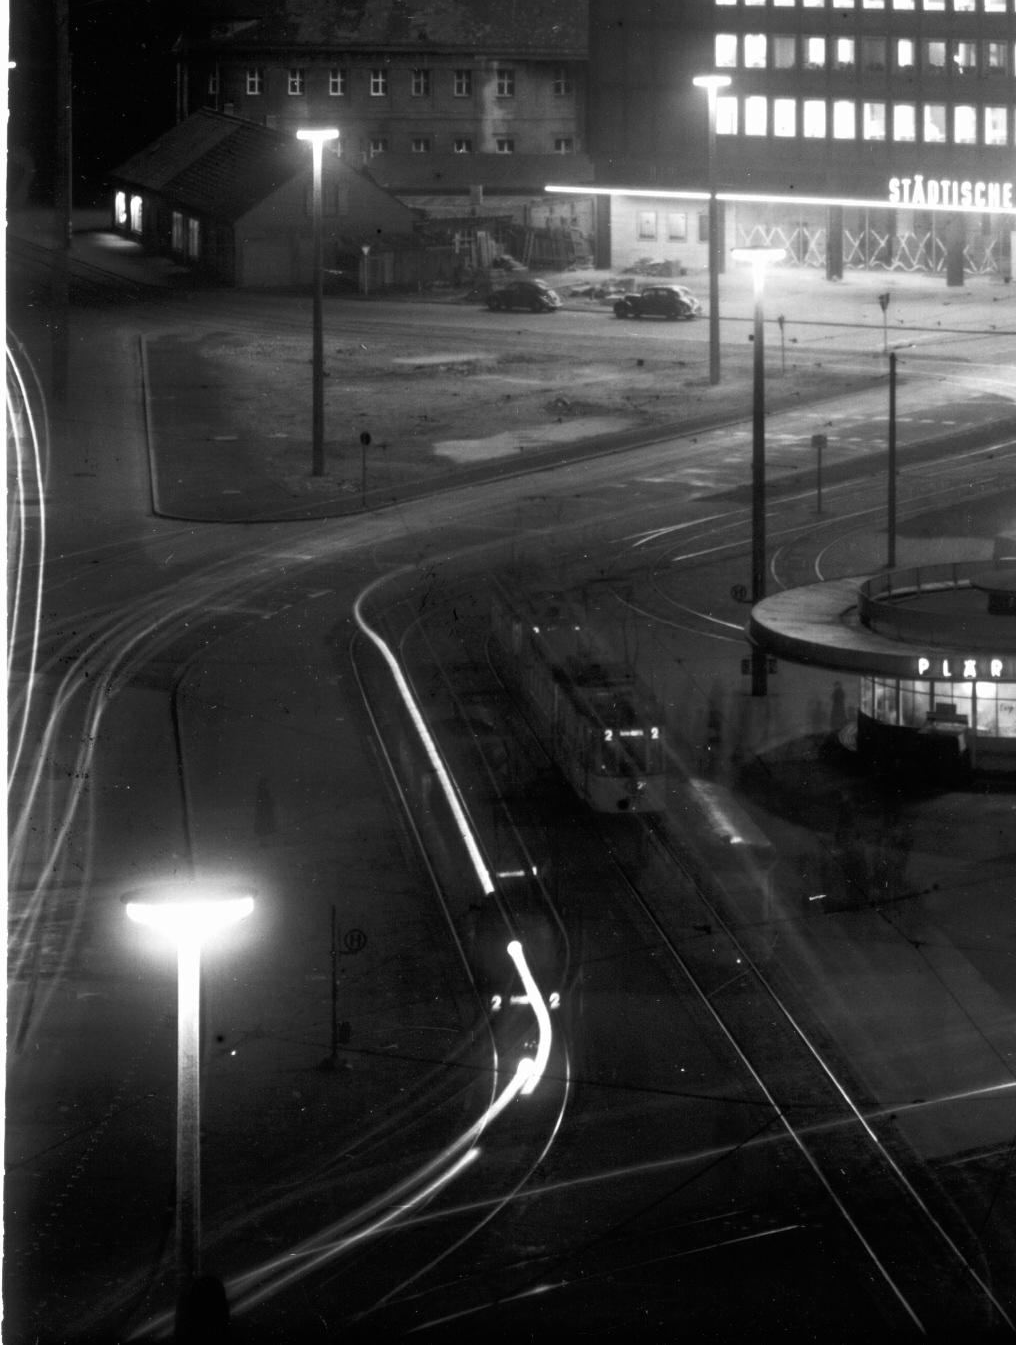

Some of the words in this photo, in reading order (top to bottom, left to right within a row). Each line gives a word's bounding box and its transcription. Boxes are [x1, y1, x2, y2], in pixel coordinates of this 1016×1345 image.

[888, 174, 1013, 208] STÄDTISCHE
[604, 729, 613, 741] 2
[650, 726, 660, 739] 2
[491, 994, 502, 1011] 2
[548, 991, 561, 1010] 2
